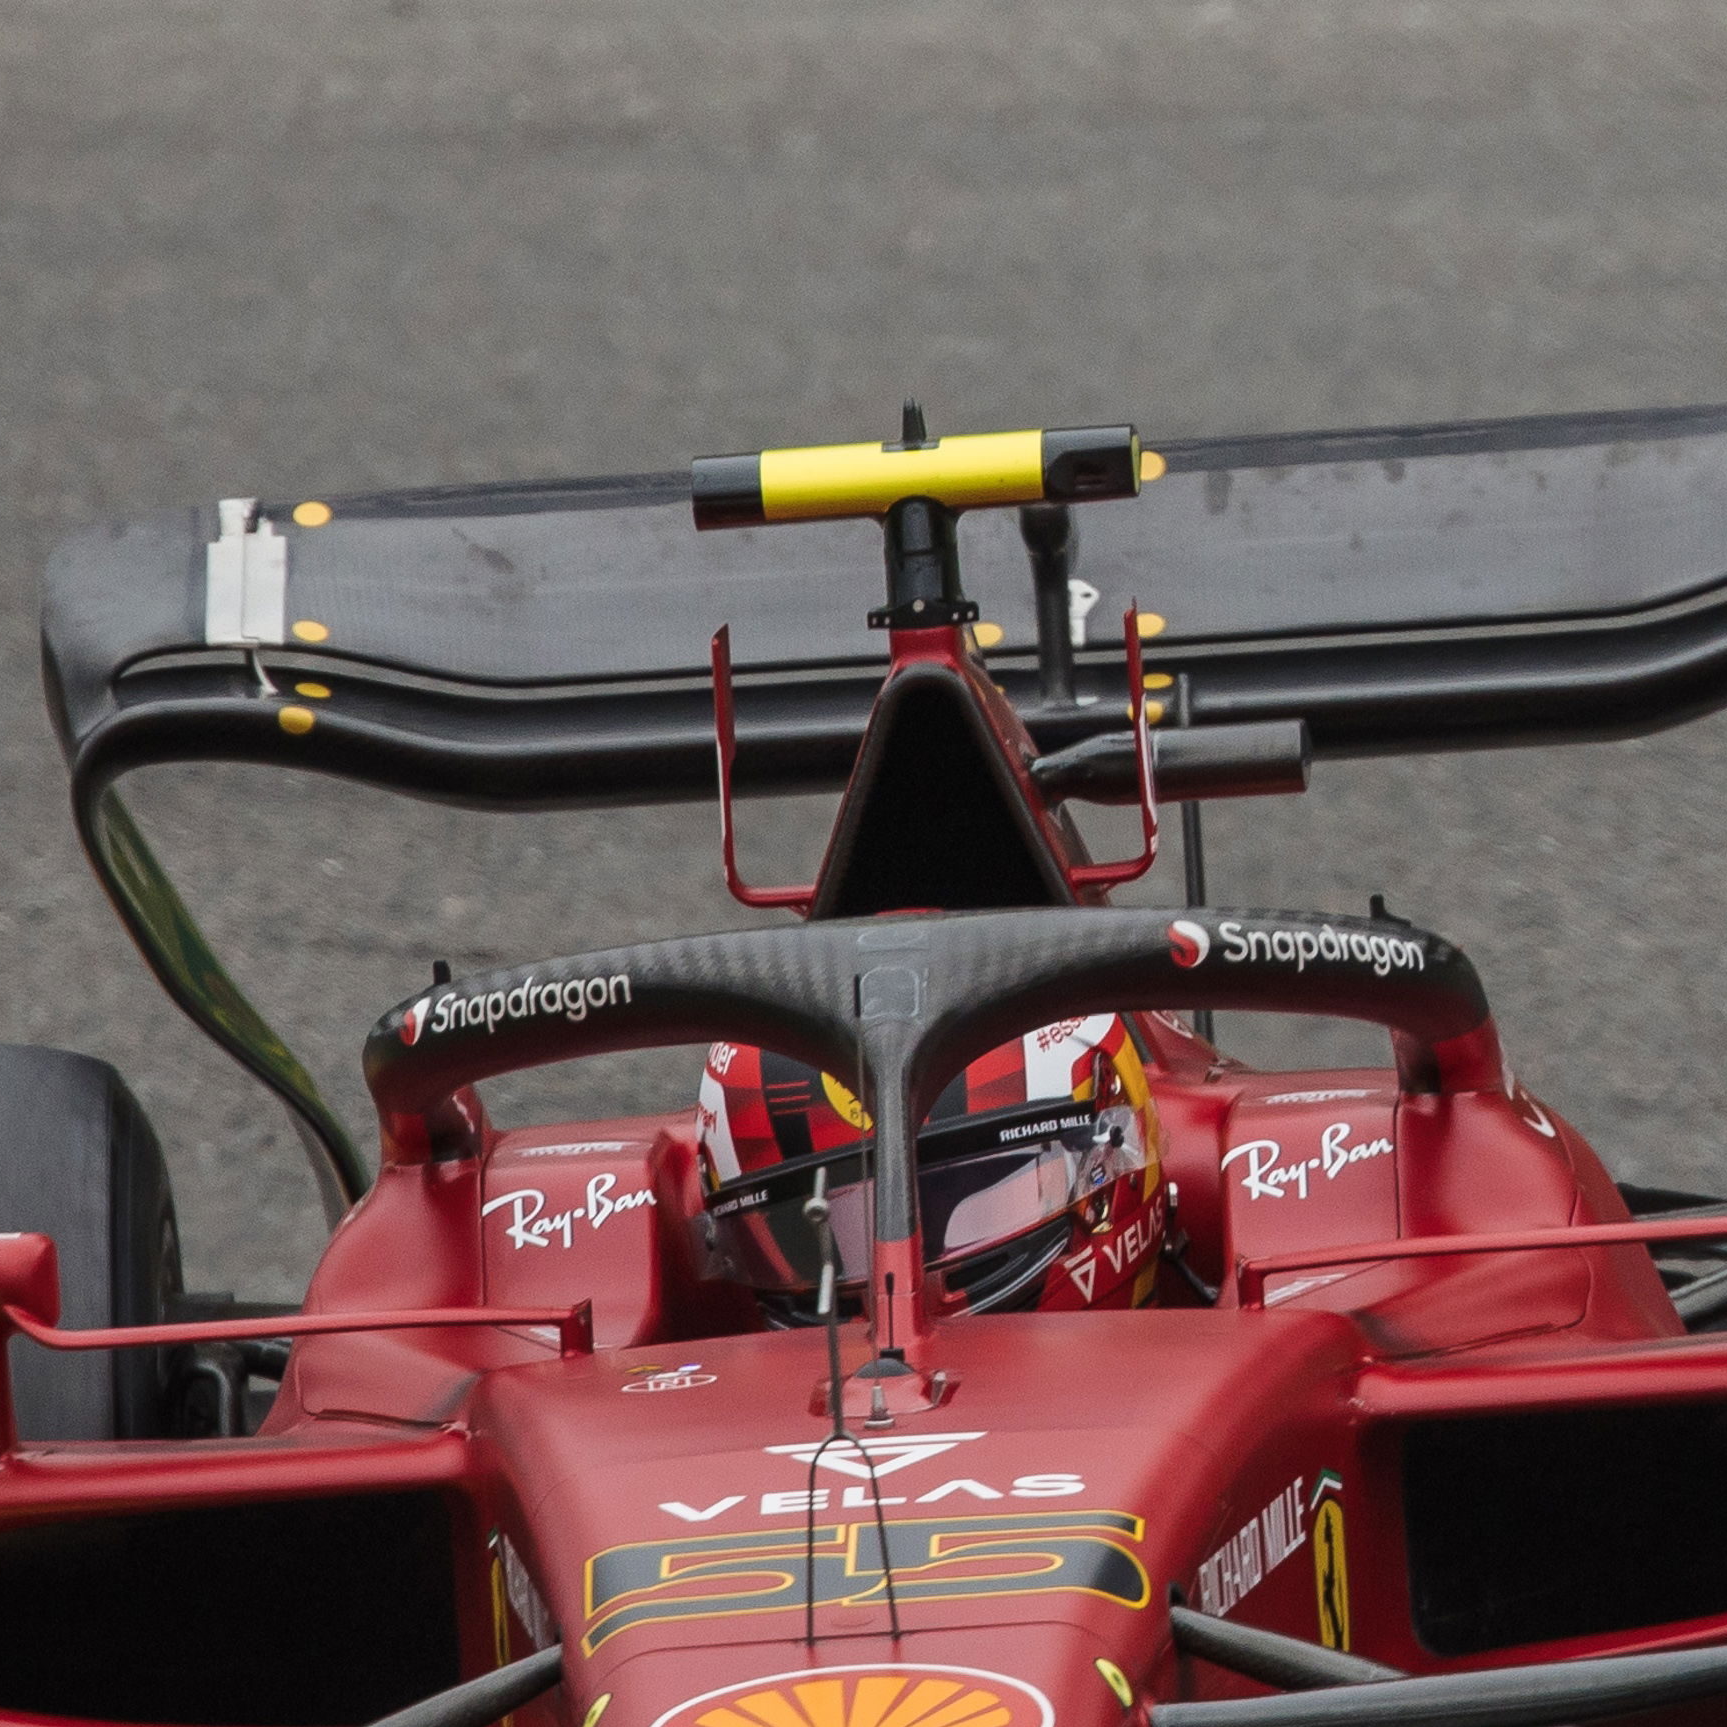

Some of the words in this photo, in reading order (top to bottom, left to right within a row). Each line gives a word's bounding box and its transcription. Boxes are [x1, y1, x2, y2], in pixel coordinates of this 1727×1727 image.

[1219, 922, 1424, 976] Snapdragon
[431, 974, 631, 1034] Snapdragon
[1000, 1119, 1058, 1142] RICHARD
[1060, 1113, 1091, 1129] MILLE
[1221, 1123, 1394, 1200] Ray-Ban
[482, 1173, 657, 1249] Ray-Ban
[1102, 1195, 1163, 1273] VELAS
[658, 1474, 1086, 1523] VELAS
[581, 1510, 1151, 1658] 55
[1198, 1517, 1263, 1618] RICHARD
[1261, 1476, 1307, 1575] MILLE
